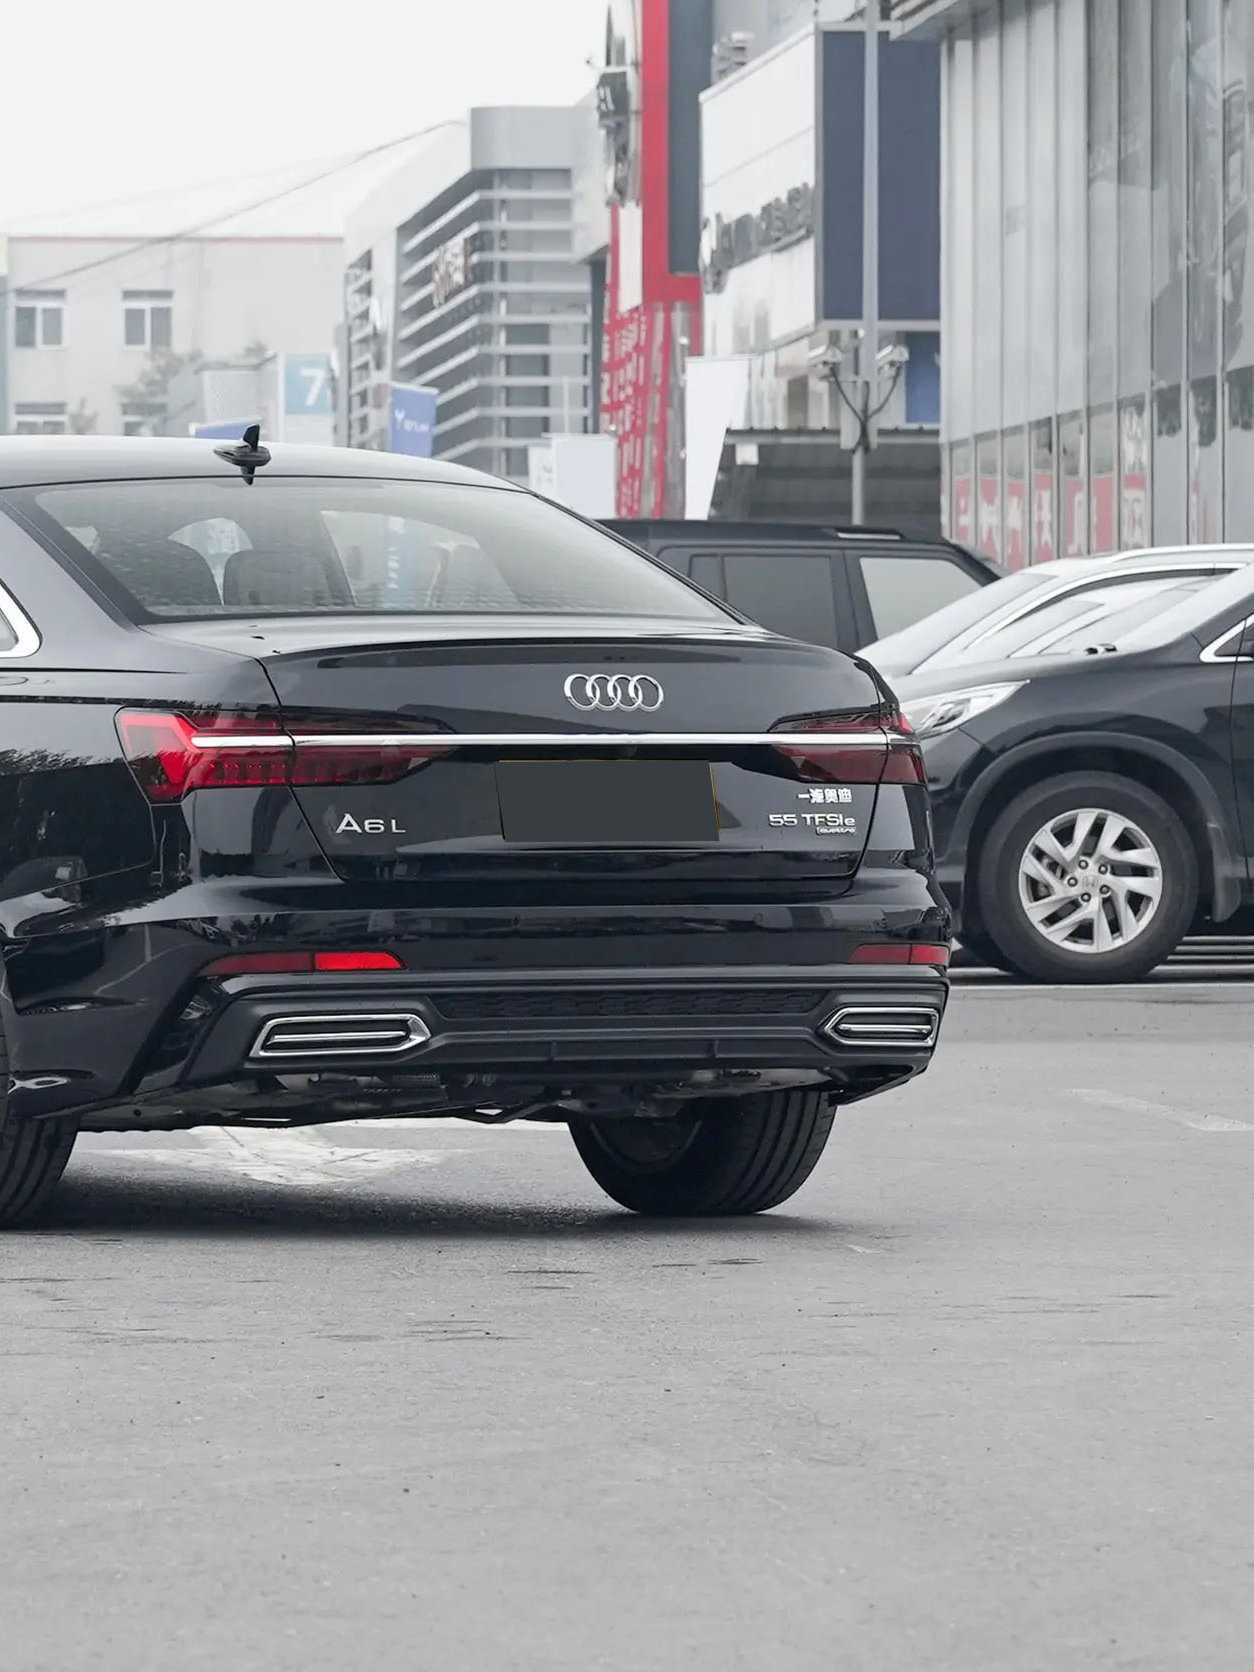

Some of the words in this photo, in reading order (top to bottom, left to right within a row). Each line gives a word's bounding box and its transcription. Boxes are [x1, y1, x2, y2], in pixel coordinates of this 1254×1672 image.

[797, 787, 853, 804] 一汽奥迪
[769, 813, 798, 827] 55
[801, 813, 856, 827] TFSIe
